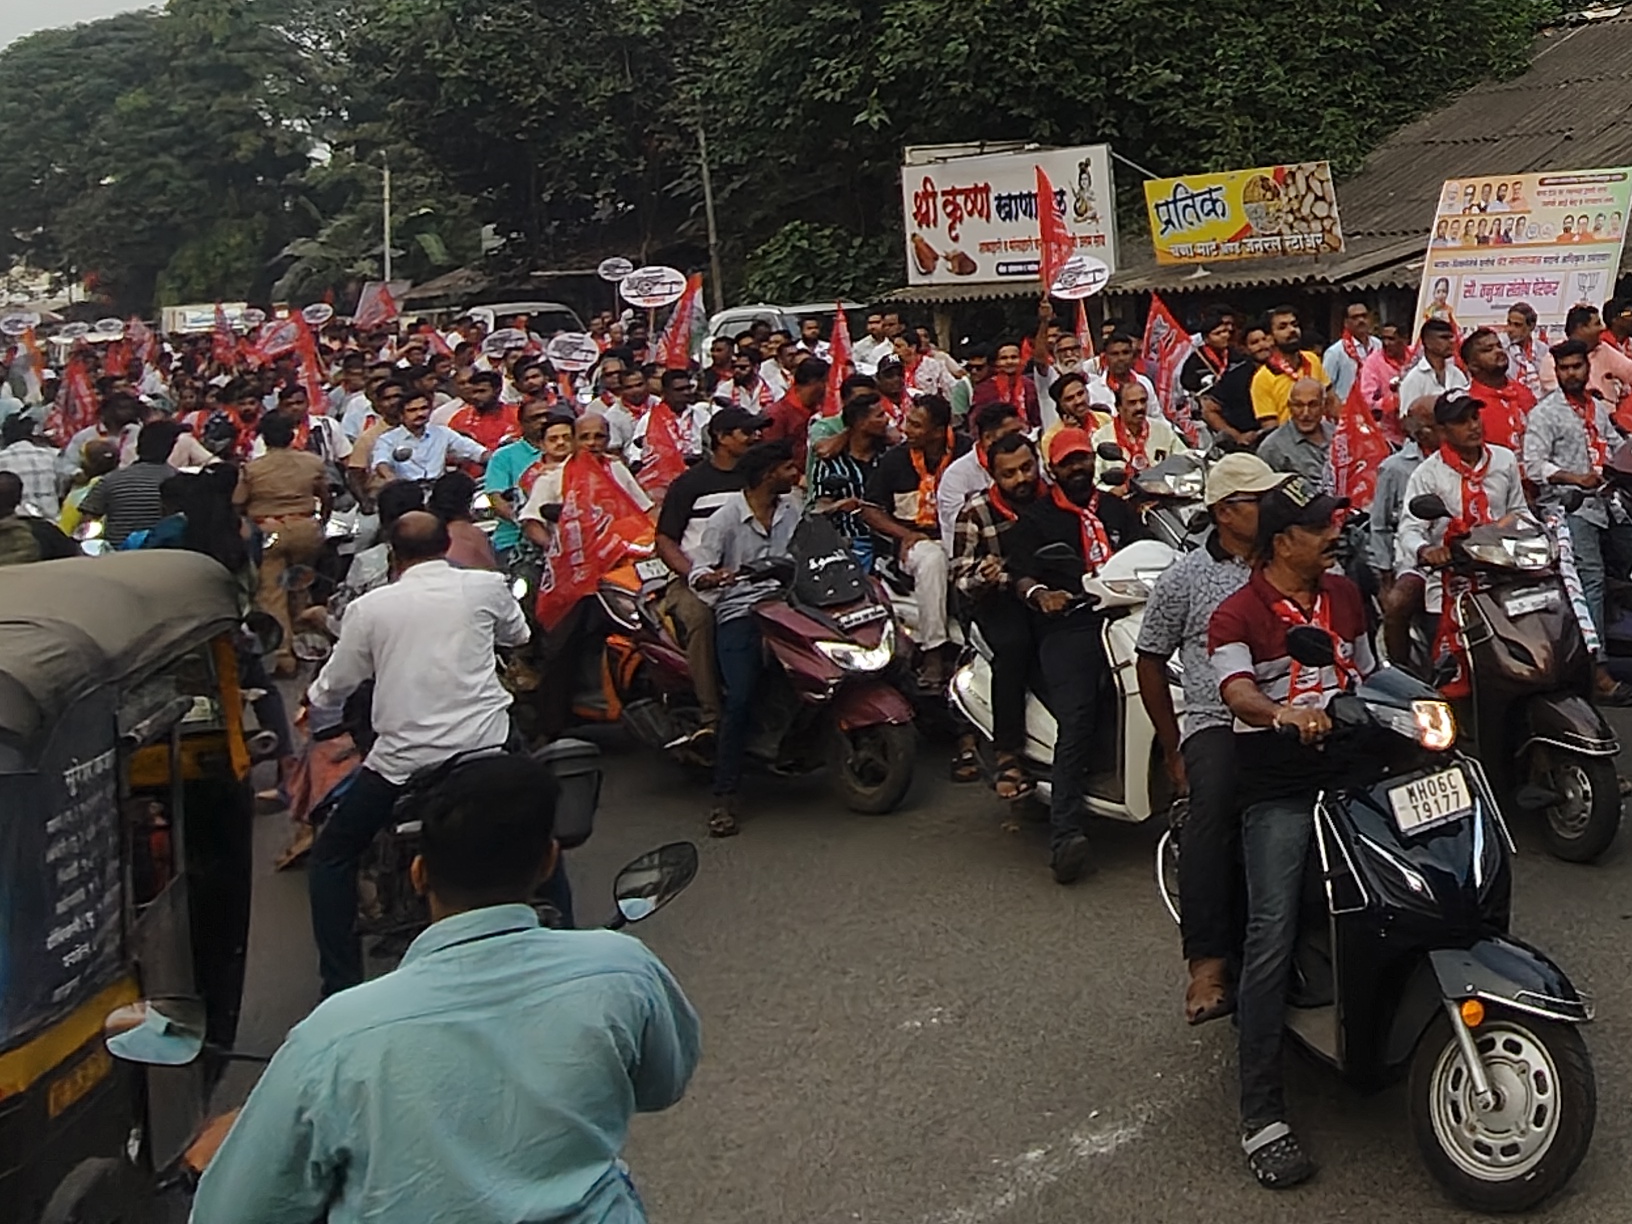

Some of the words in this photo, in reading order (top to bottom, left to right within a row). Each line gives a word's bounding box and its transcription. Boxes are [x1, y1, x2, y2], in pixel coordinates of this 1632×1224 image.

[912, 176, 938, 229] श्री
[994, 187, 1068, 223] खाणाळ
[1155, 182, 1227, 236] प्रतिक
[1406, 773, 1458, 804] MH06C
[1411, 791, 1461, 823] T9177
